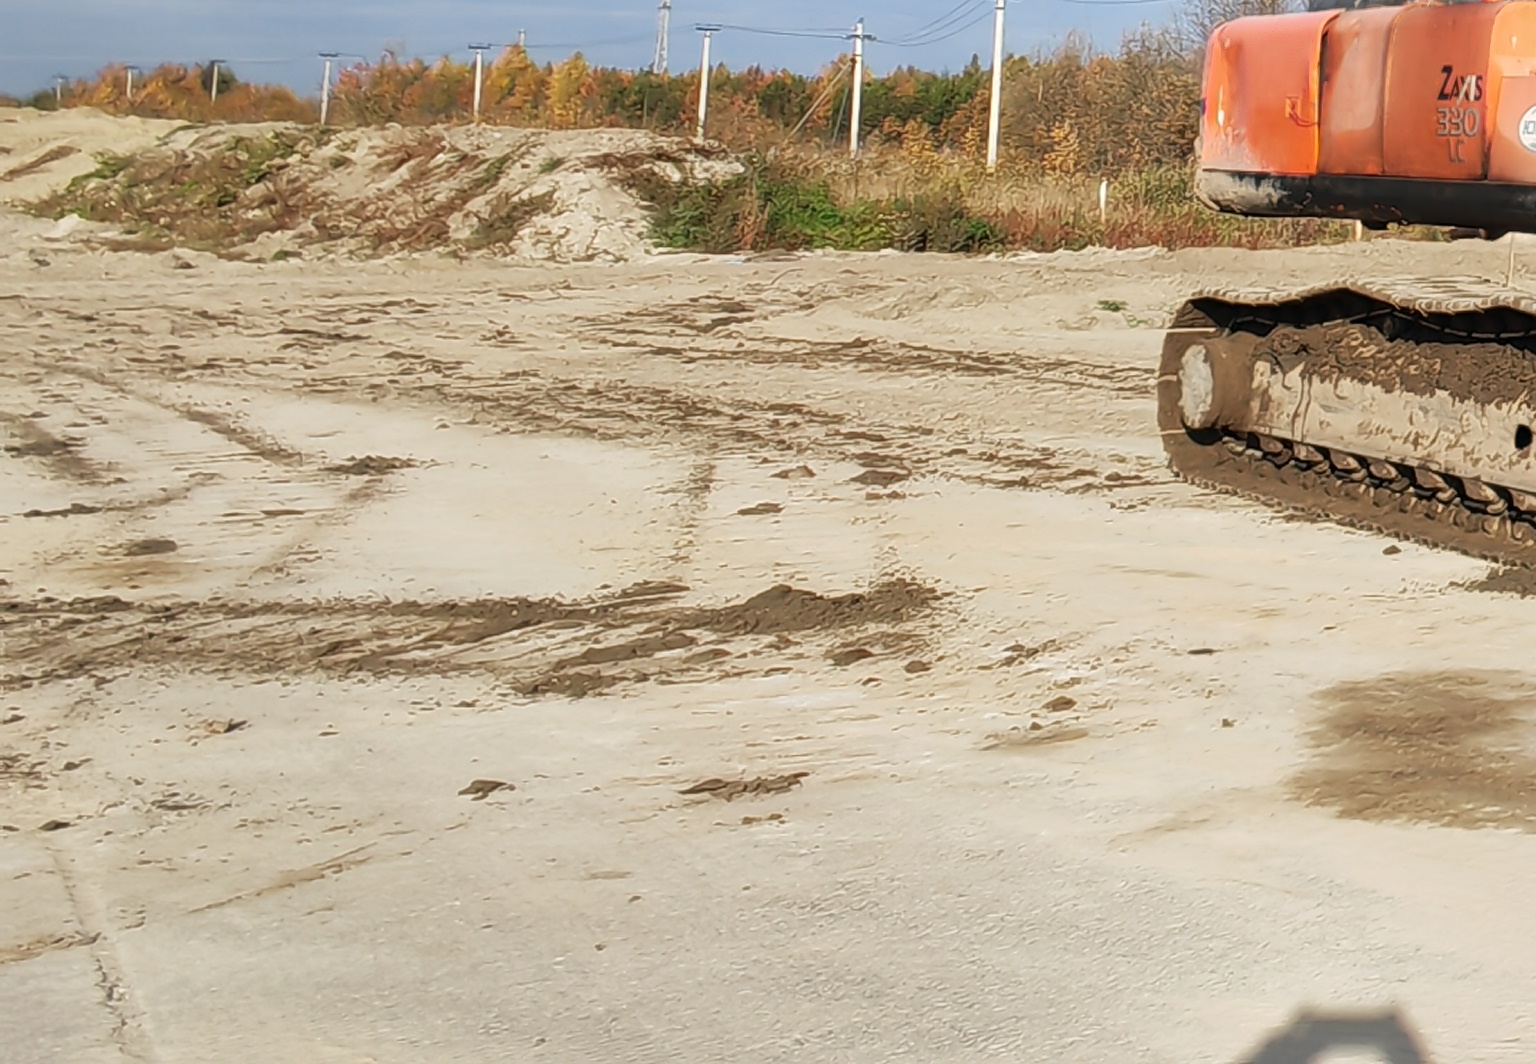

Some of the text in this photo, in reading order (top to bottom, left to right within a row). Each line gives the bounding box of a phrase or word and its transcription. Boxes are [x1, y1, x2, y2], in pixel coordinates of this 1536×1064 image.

[1437, 65, 1483, 103] ZAXIS
[1437, 107, 1480, 136] 330
[1448, 137, 1465, 163] LC
